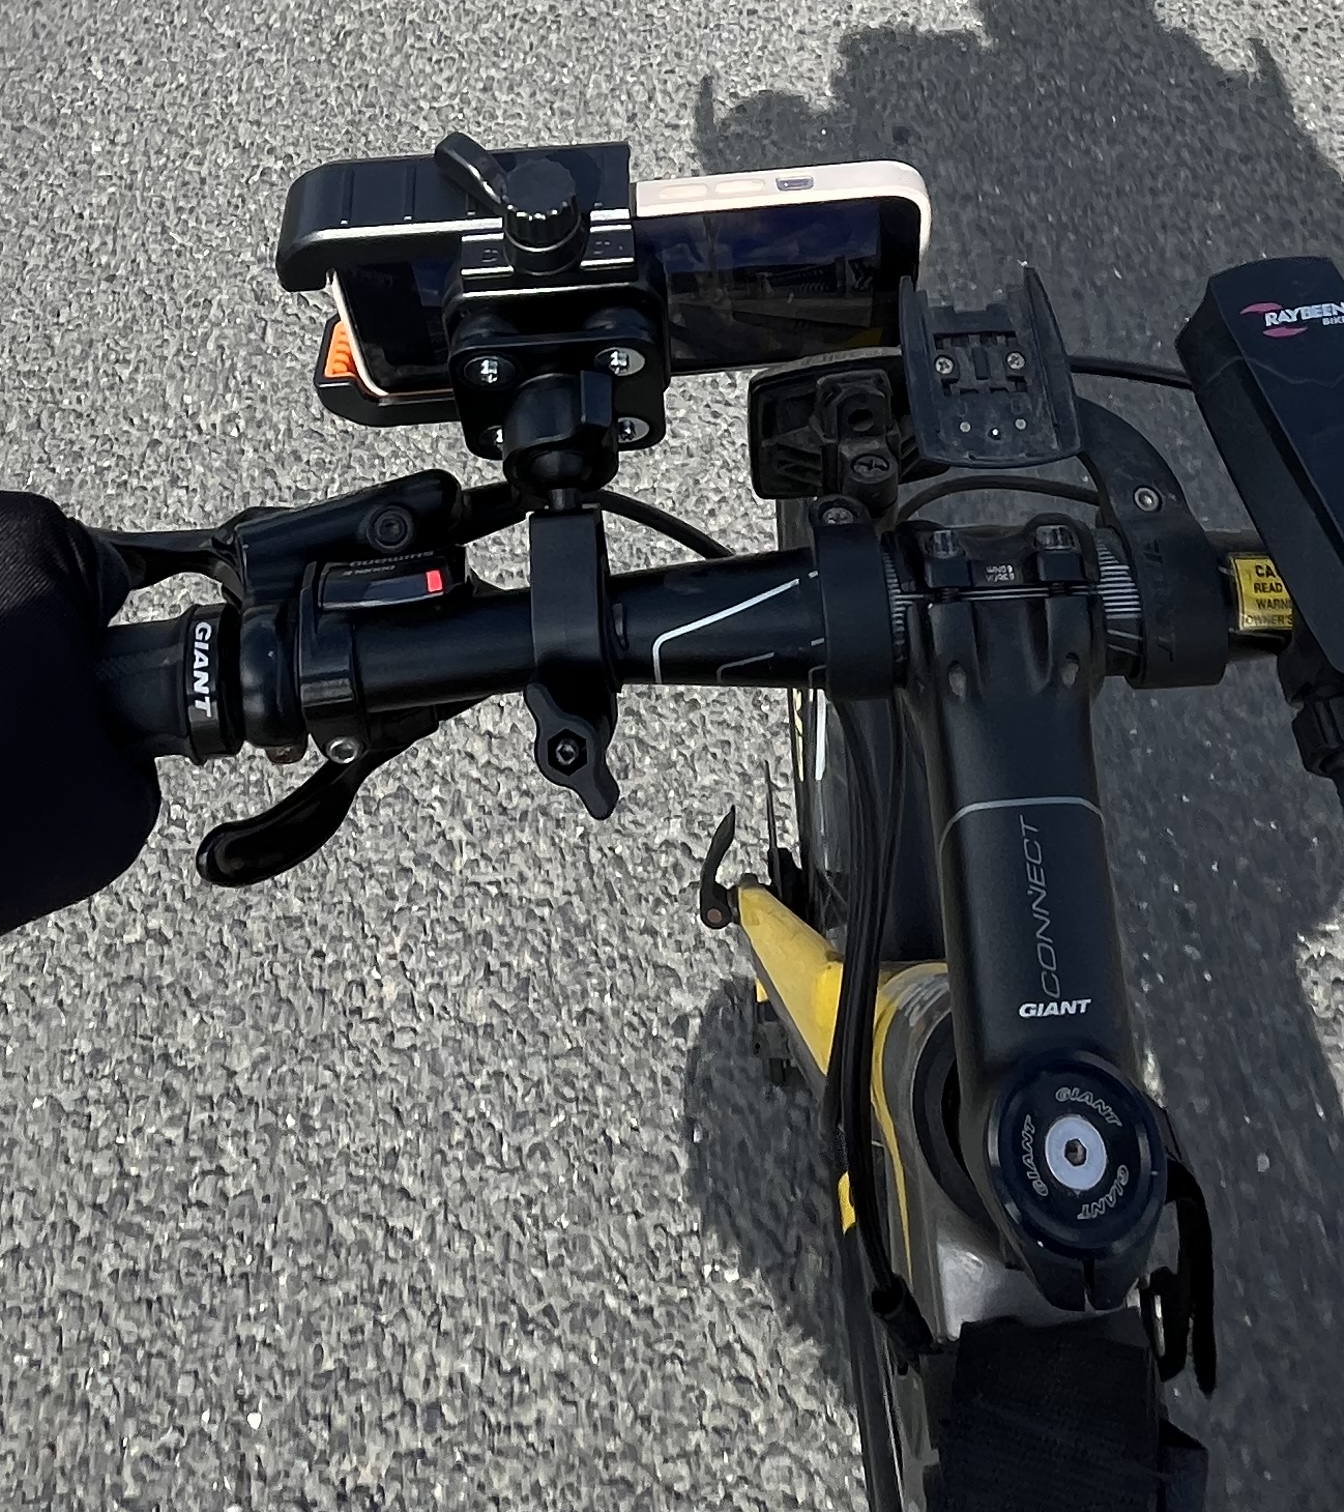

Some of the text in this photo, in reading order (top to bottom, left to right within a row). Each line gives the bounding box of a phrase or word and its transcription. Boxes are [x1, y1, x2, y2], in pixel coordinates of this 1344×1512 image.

[1254, 582, 1283, 593] READ
[1255, 564, 1276, 578] CA
[193, 621, 212, 718] GIANT
[1020, 814, 1061, 999] CONNECT
[1019, 999, 1091, 1018] GIANT
[1056, 1087, 1123, 1127] GIANT
[1022, 1114, 1049, 1197] GIANT
[1077, 1164, 1129, 1220] GIANT
